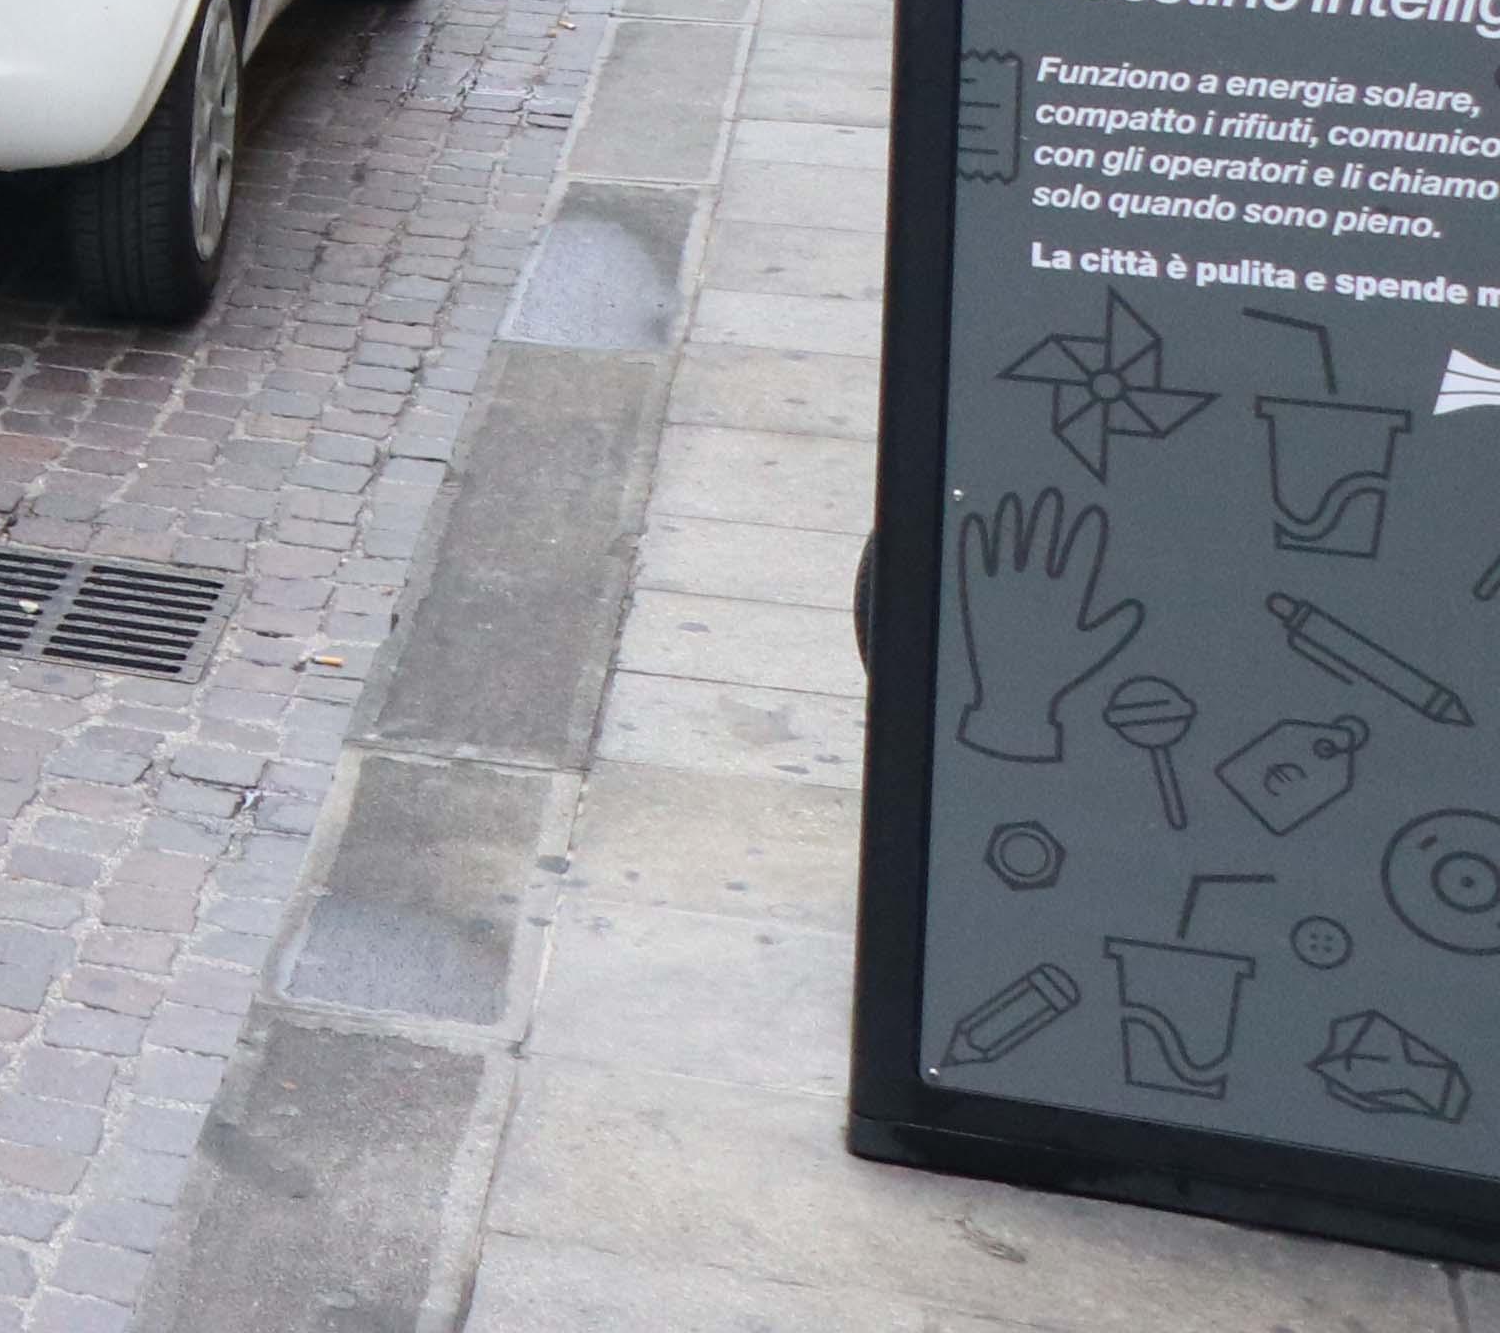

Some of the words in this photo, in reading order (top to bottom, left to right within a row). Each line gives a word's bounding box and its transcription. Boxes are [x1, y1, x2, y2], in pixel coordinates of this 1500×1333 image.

[1036, 56, 1191, 94] Funziono
[1197, 74, 1218, 94] a
[1225, 75, 1356, 108] energia
[1362, 82, 1482, 118] solare,
[1035, 103, 1197, 134] compatto
[1202, 110, 1216, 135] i
[1219, 112, 1319, 147] rifiuti,
[1328, 123, 1500, 159] comunico
[1033, 145, 1095, 169] con
[1101, 146, 1144, 178] gli
[1149, 151, 1309, 186] operatori
[1311, 166, 1336, 188] e
[1342, 161, 1365, 190] li
[1368, 166, 1500, 202] chiamo
[1032, 183, 1101, 211] solo
[1107, 187, 1237, 222] quando
[1242, 202, 1328, 230] sono
[1332, 207, 1443, 239] pieno.
[1031, 241, 1072, 270] La
[1080, 247, 1159, 278] città
[1165, 251, 1188, 280] è
[1196, 257, 1297, 290] pulita
[1304, 269, 1328, 293] e
[1334, 272, 1469, 307] spende
